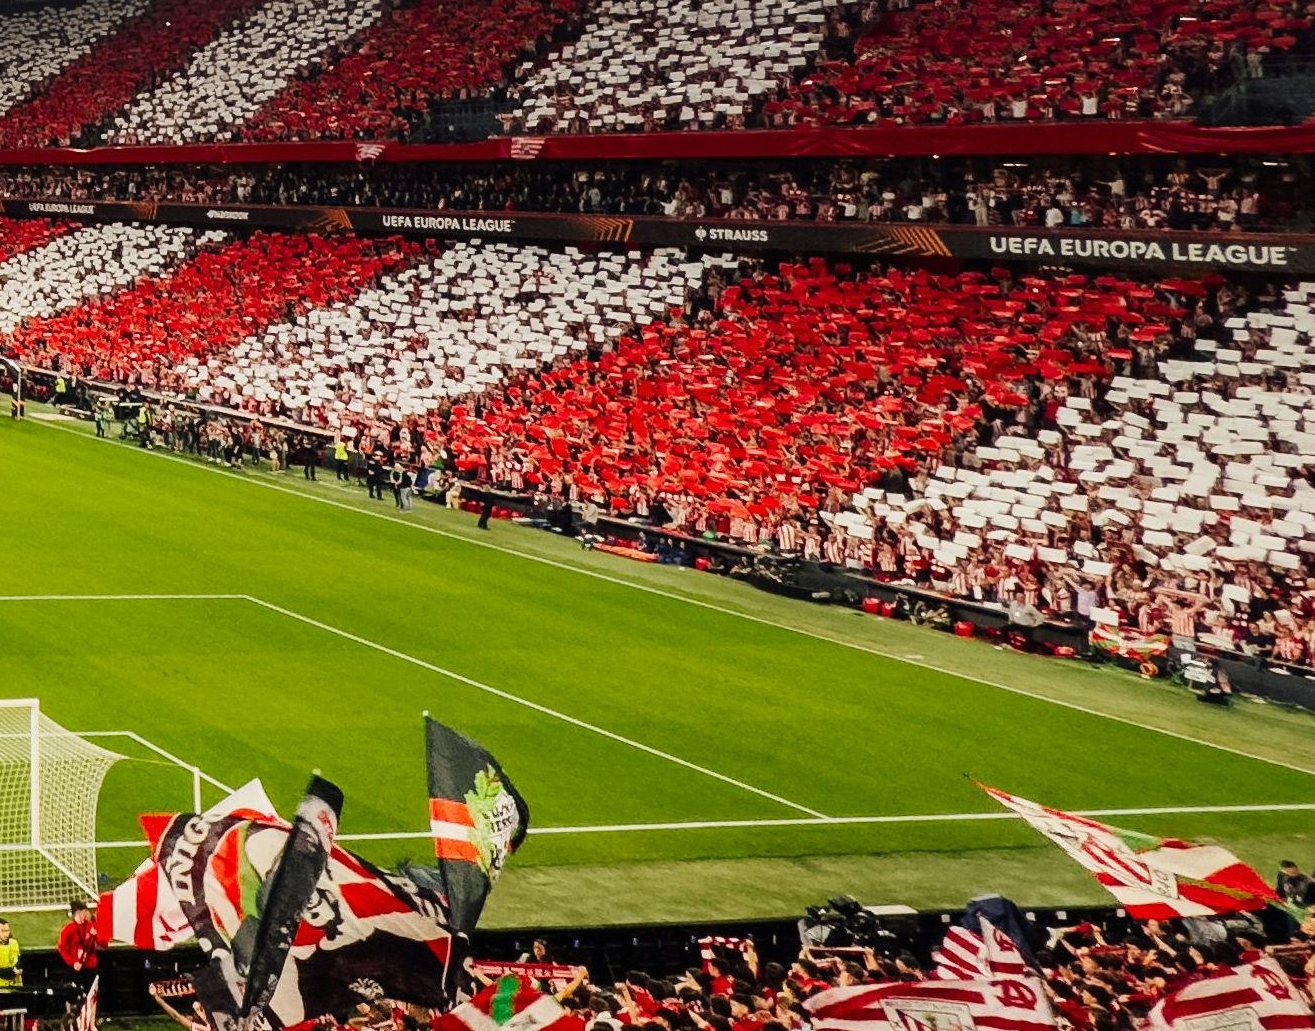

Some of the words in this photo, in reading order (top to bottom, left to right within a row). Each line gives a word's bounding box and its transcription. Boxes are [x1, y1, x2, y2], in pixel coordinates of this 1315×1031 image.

[383, 216, 412, 227] UEFA
[414, 217, 460, 229] EUROPA
[463, 219, 511, 231] LEAGUE
[710, 229, 768, 241] STRAUSS
[990, 237, 1054, 254] UEFA
[1061, 239, 1165, 259] EUROPA
[1172, 244, 1287, 264] LEAGUE
